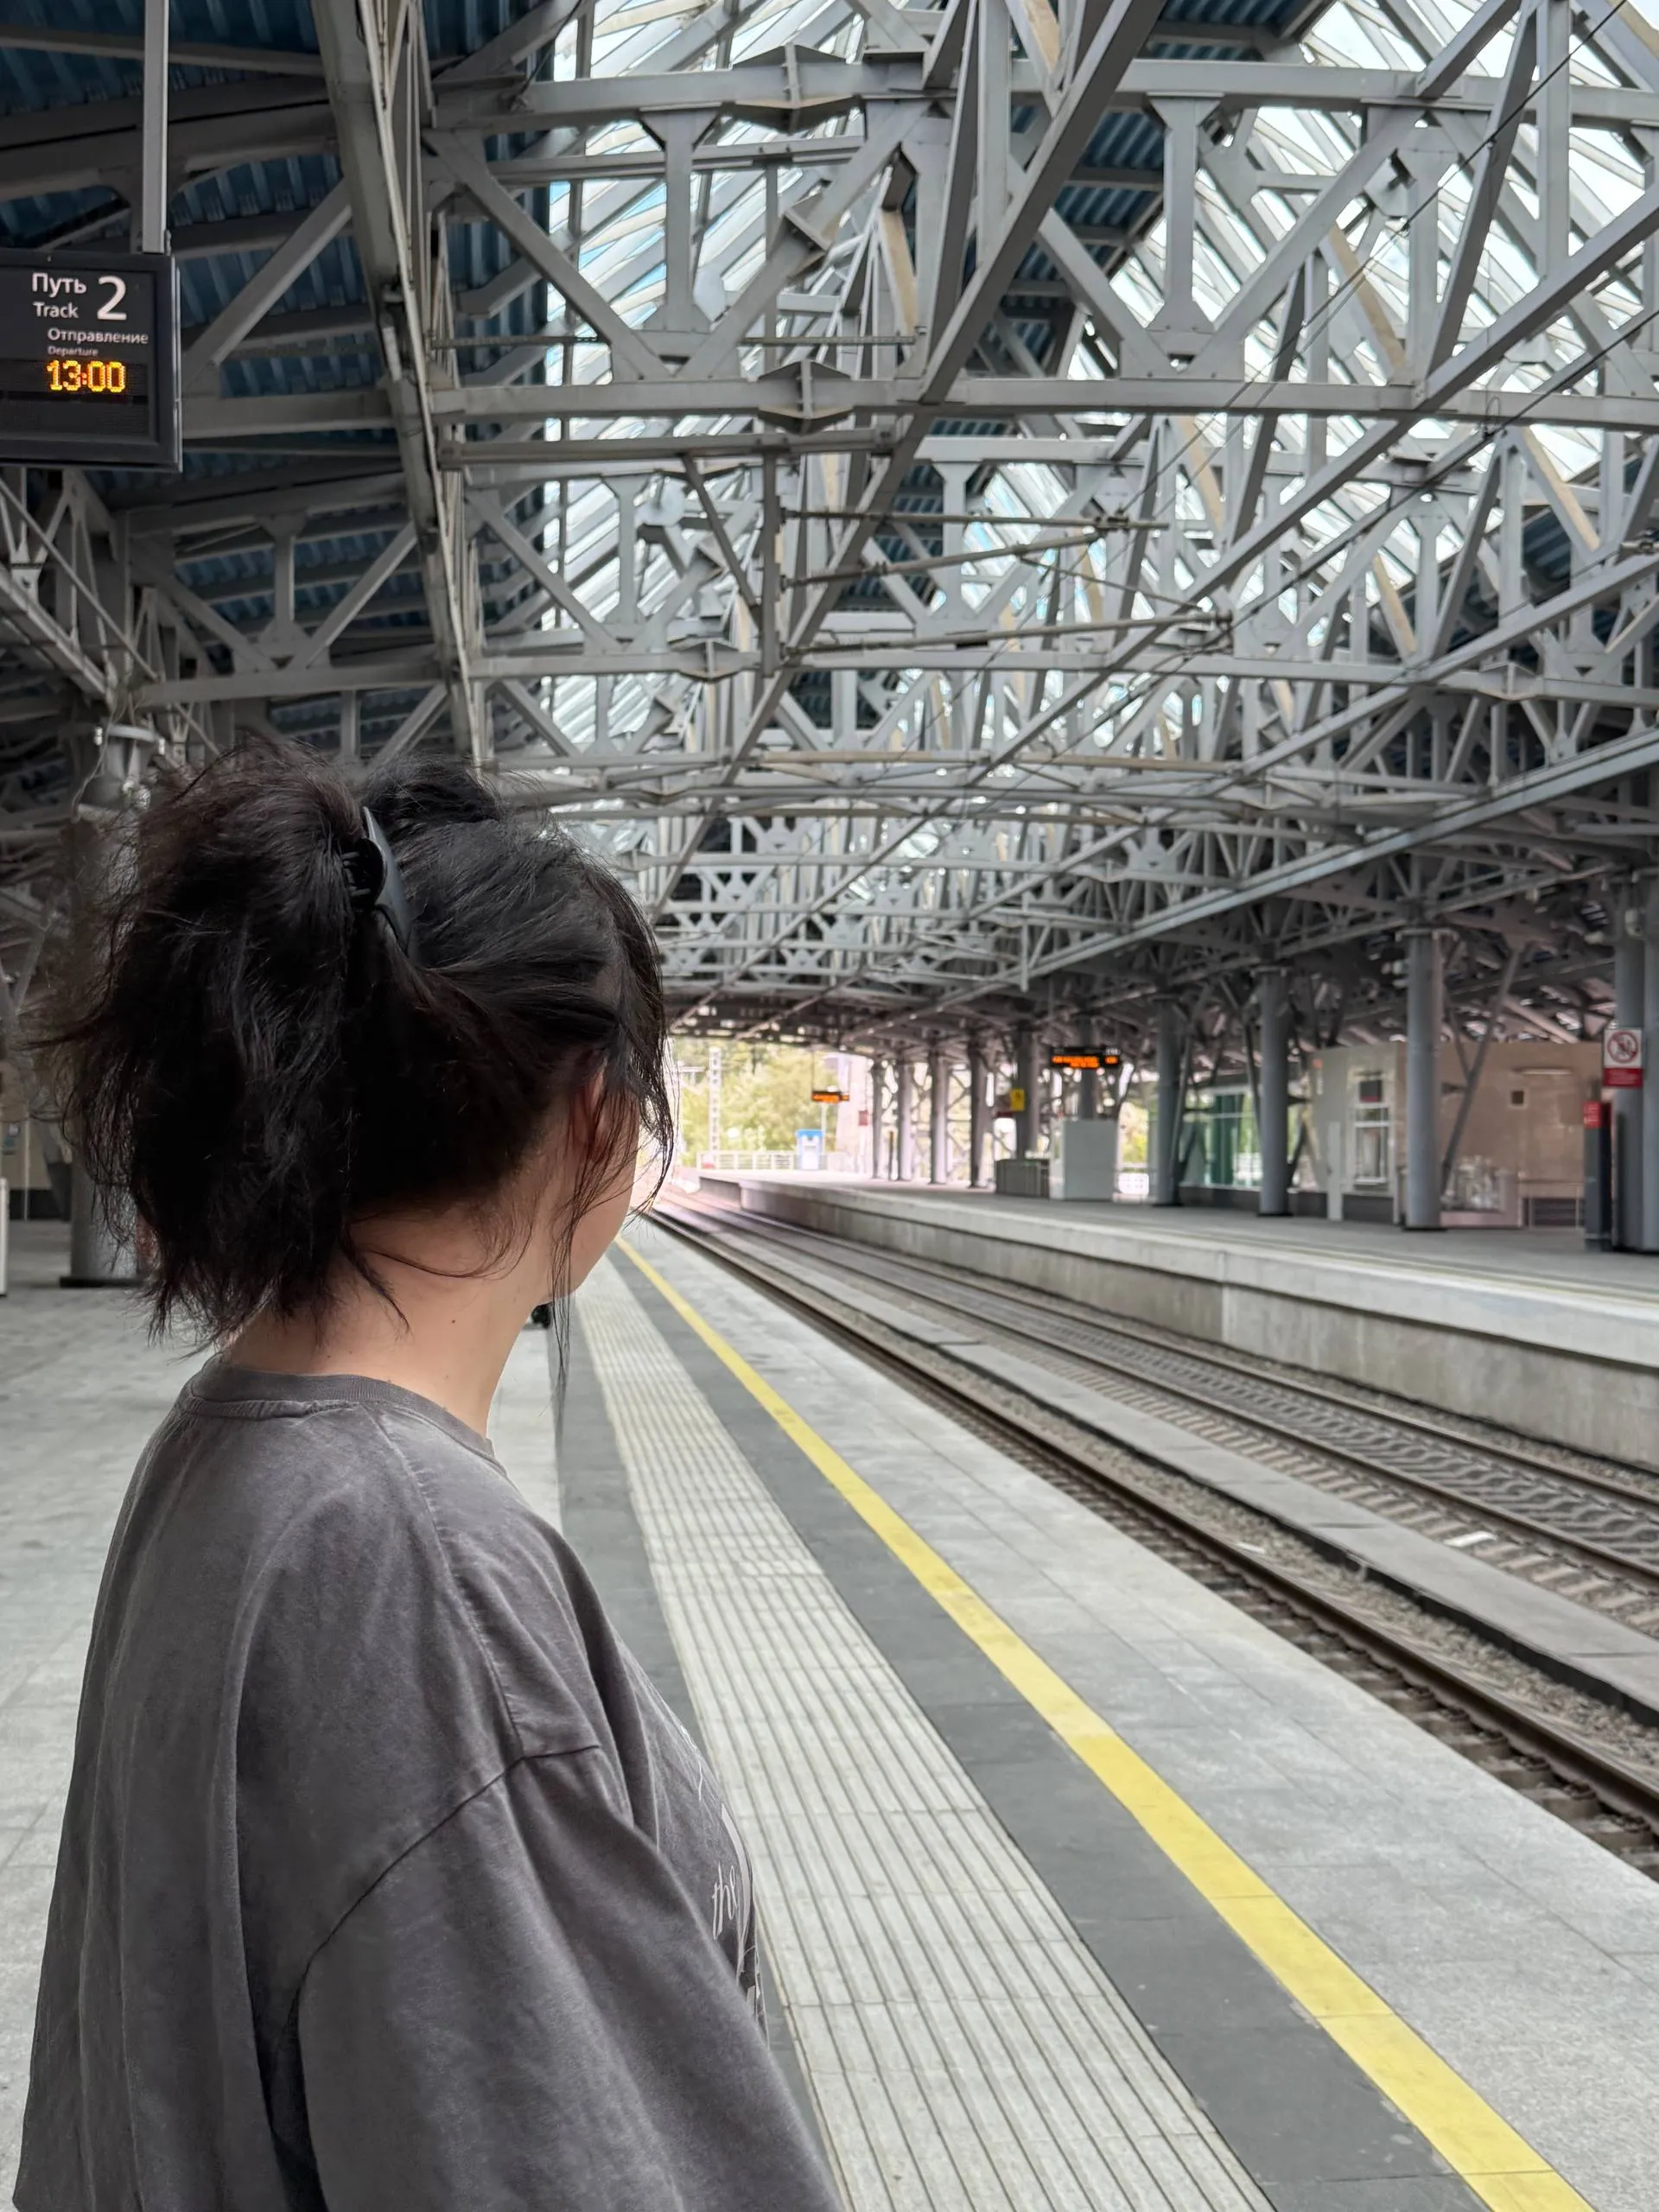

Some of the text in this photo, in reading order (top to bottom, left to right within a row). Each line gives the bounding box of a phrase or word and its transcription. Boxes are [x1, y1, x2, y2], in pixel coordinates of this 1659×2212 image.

[32, 272, 127, 321] Путь 2
[33, 302, 79, 319] Track
[48, 327, 149, 345] Отправление
[48, 346, 99, 356] Departure
[47, 359, 125, 392] 13:00
